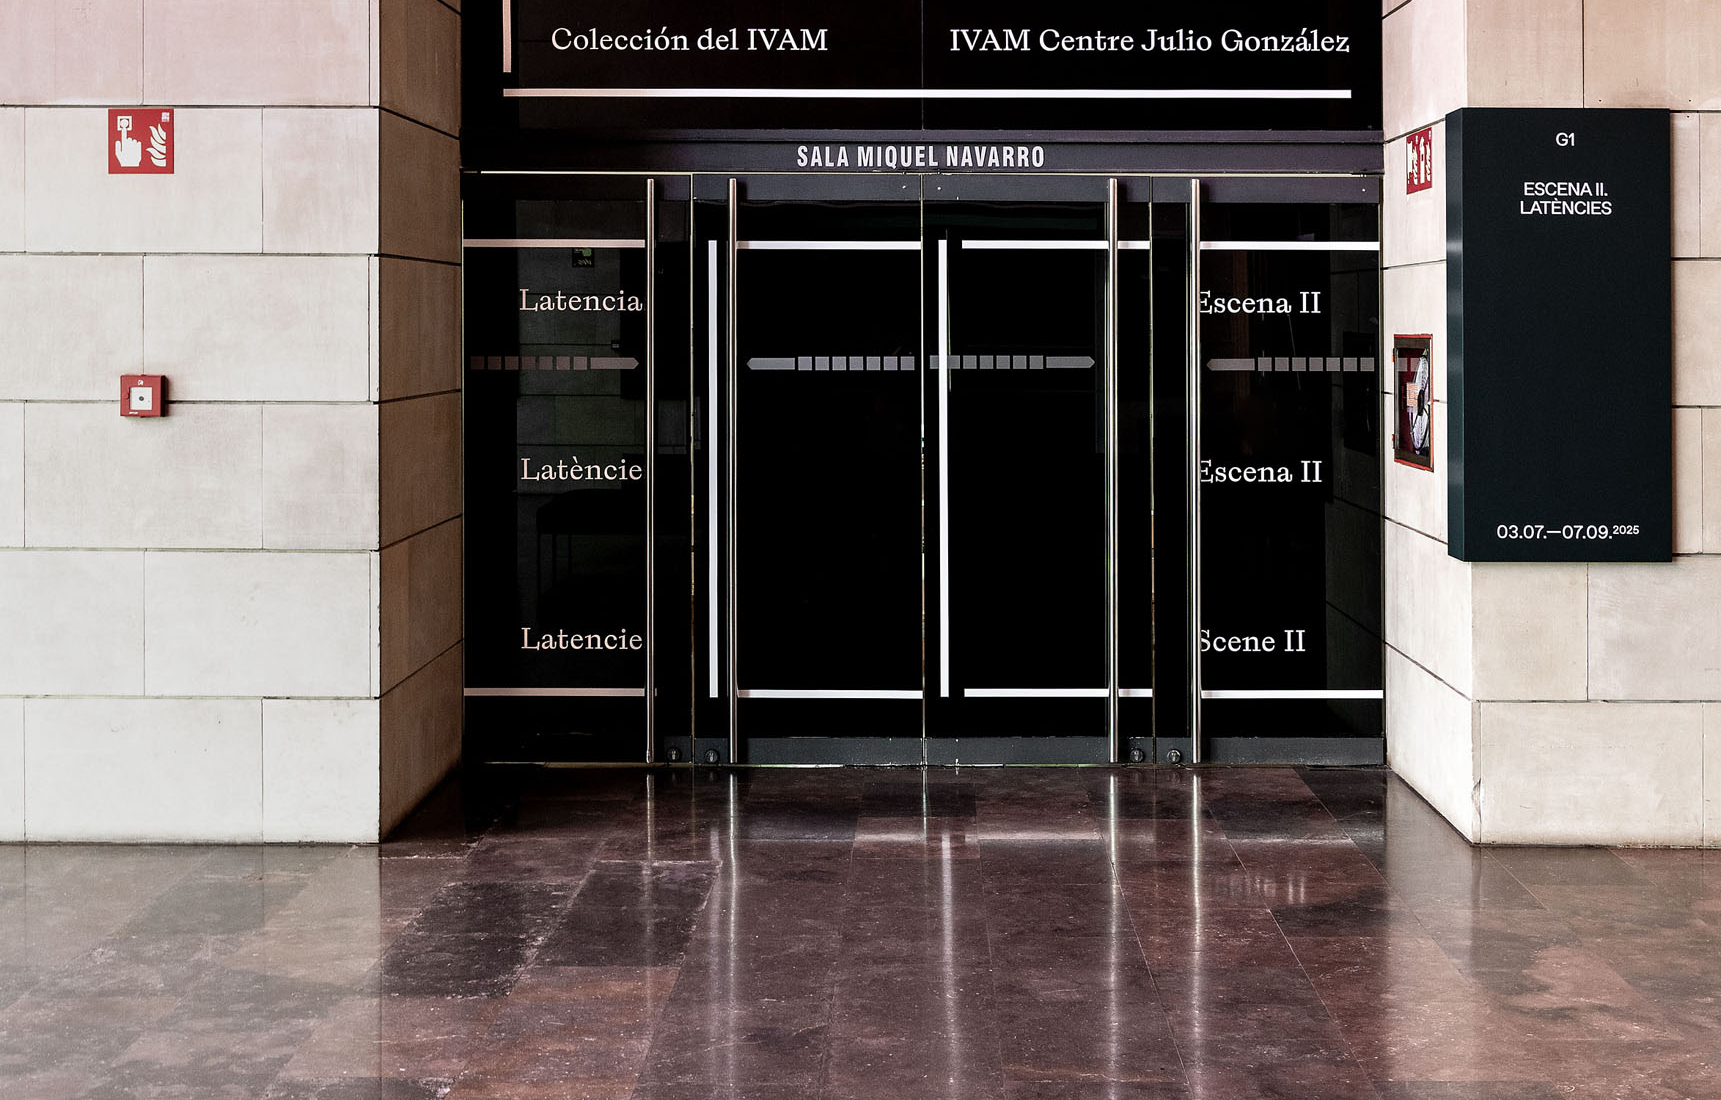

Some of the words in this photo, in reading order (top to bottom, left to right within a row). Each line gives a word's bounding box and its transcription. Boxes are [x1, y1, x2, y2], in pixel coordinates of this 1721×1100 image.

[551, 26, 690, 51] Colección
[696, 27, 740, 51] del
[747, 28, 829, 51] IVAM
[949, 28, 1031, 52] IVAM
[1039, 28, 1134, 52] Centre
[1140, 28, 1212, 52] Julio
[1221, 27, 1351, 53] González
[1554, 131, 1576, 148] G1
[796, 145, 850, 168] SALA
[857, 145, 939, 170] MIQUEL
[946, 145, 1046, 169] NAVARRO
[1523, 181, 1593, 197] ESCENA
[1595, 181, 1609, 197] II.
[1520, 197, 1613, 216] LATÈNCIES
[519, 288, 644, 312] Latencia
[1299, 291, 1322, 314] II
[520, 455, 644, 482] Latèncie
[1300, 460, 1323, 483] II
[520, 627, 644, 651] Latencie
[1283, 629, 1306, 652] II
